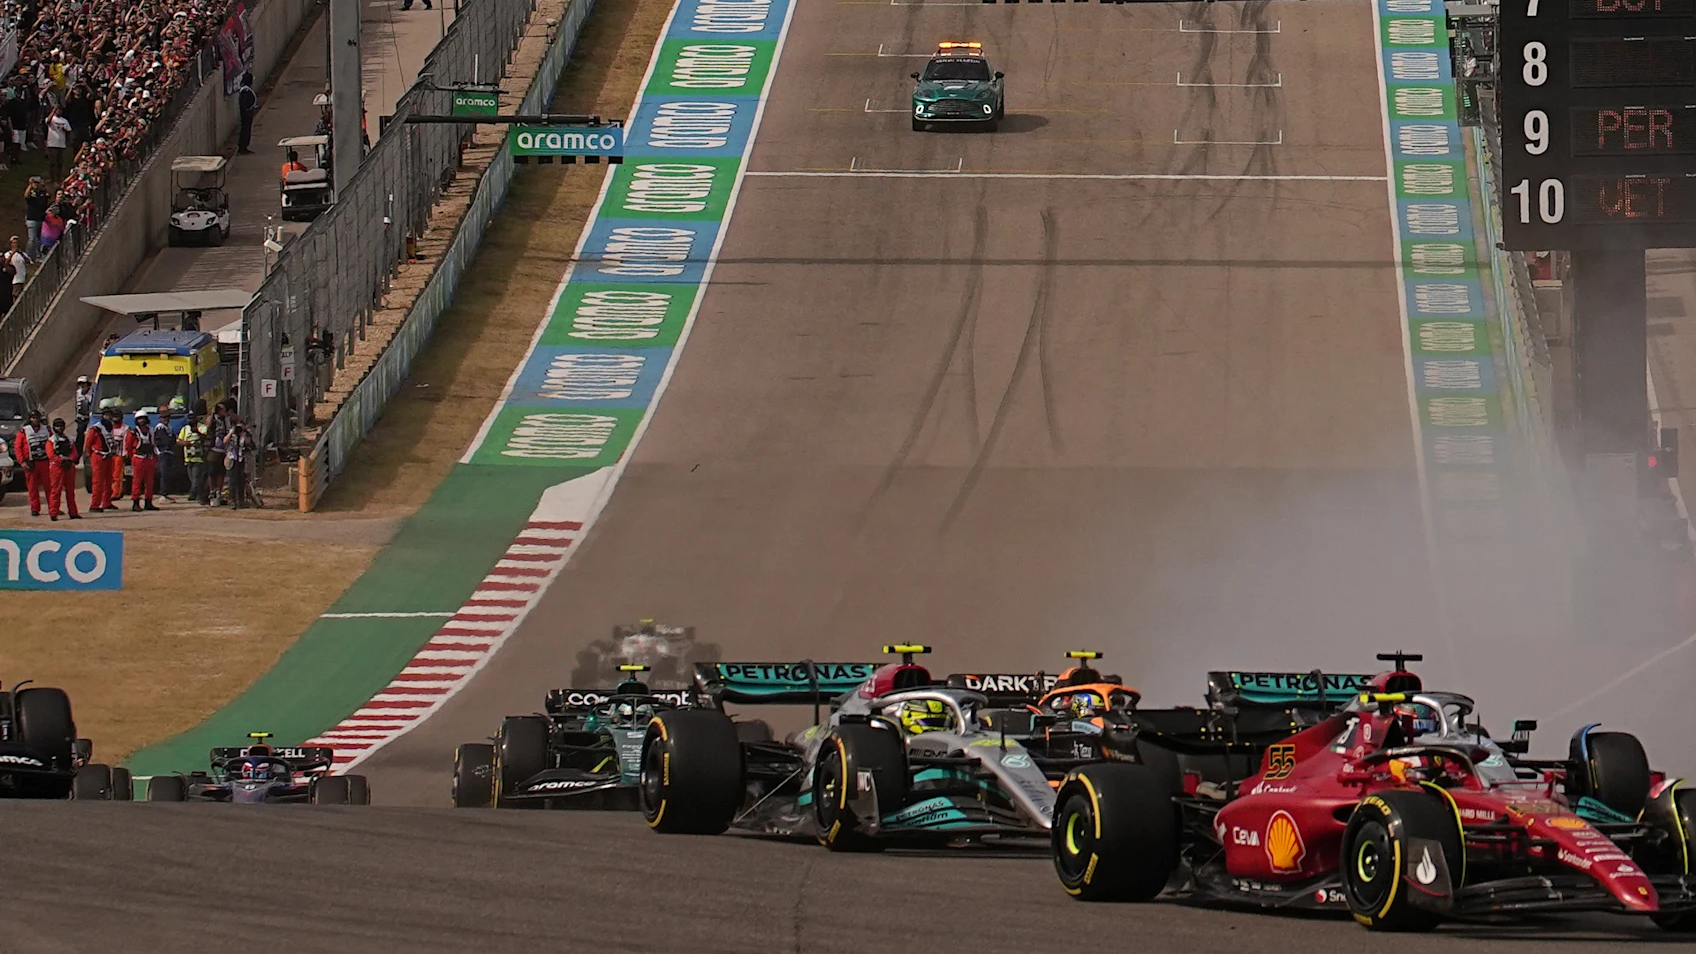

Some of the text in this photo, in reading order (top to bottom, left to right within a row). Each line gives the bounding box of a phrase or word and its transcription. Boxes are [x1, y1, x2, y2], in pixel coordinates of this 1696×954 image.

[669, 45, 756, 88] aramco
[1522, 41, 1548, 86] 8
[456, 98, 495, 106] aramco
[517, 133, 615, 150] aramco
[648, 102, 737, 148] aramco
[1523, 109, 1673, 155] 9 PER
[622, 164, 717, 213] aramco
[1510, 178, 1565, 224] 10
[597, 227, 697, 276] aramco
[568, 291, 672, 340] aramco
[537, 354, 646, 400] aramco
[501, 413, 618, 458] aramco
[725, 665, 867, 681] PETRONAS
[1263, 744, 1296, 780] 55
[528, 781, 596, 791] aramco
